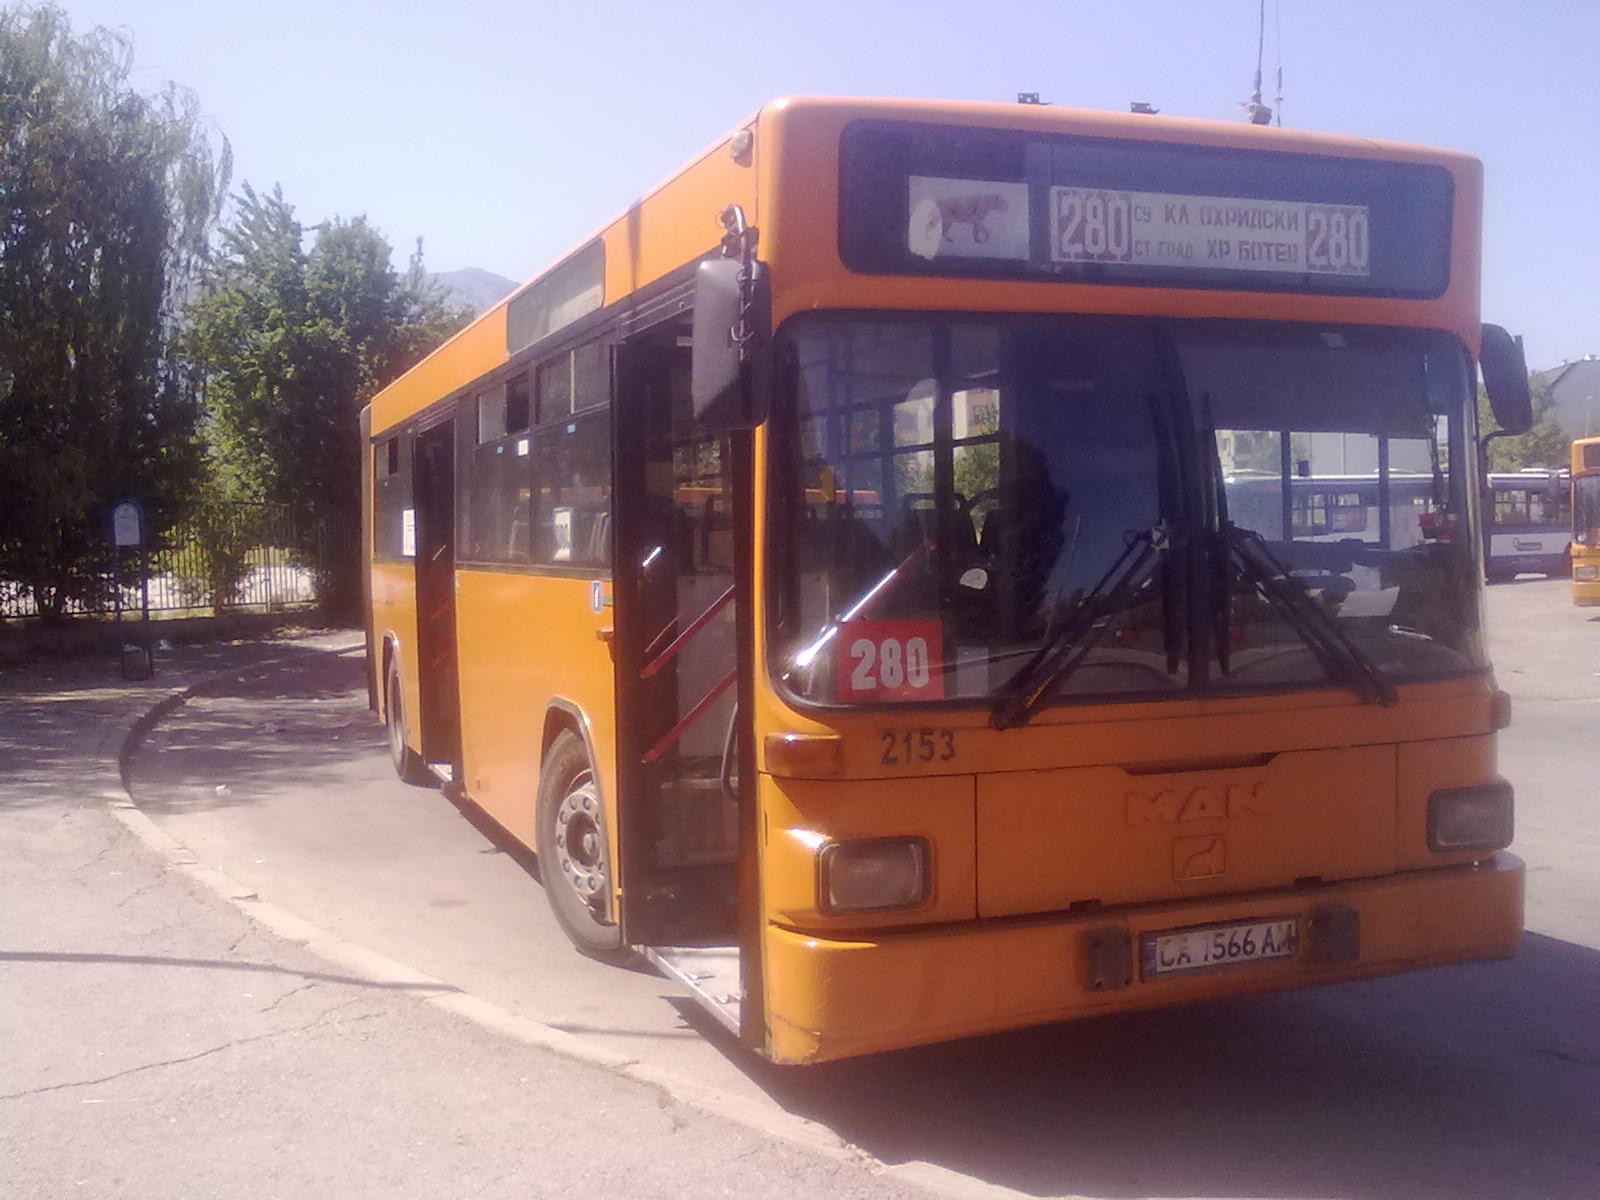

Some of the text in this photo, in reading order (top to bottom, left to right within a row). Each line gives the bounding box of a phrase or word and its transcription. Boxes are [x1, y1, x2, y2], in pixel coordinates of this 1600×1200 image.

[1060, 194, 1129, 256] 280
[1164, 203, 1190, 225] КЛ
[1199, 205, 1299, 232] ОХРИДСКИ
[1308, 211, 1369, 269] 280
[1207, 238, 1231, 260] ХР
[851, 637, 929, 690] 280
[881, 728, 955, 765] 2153
